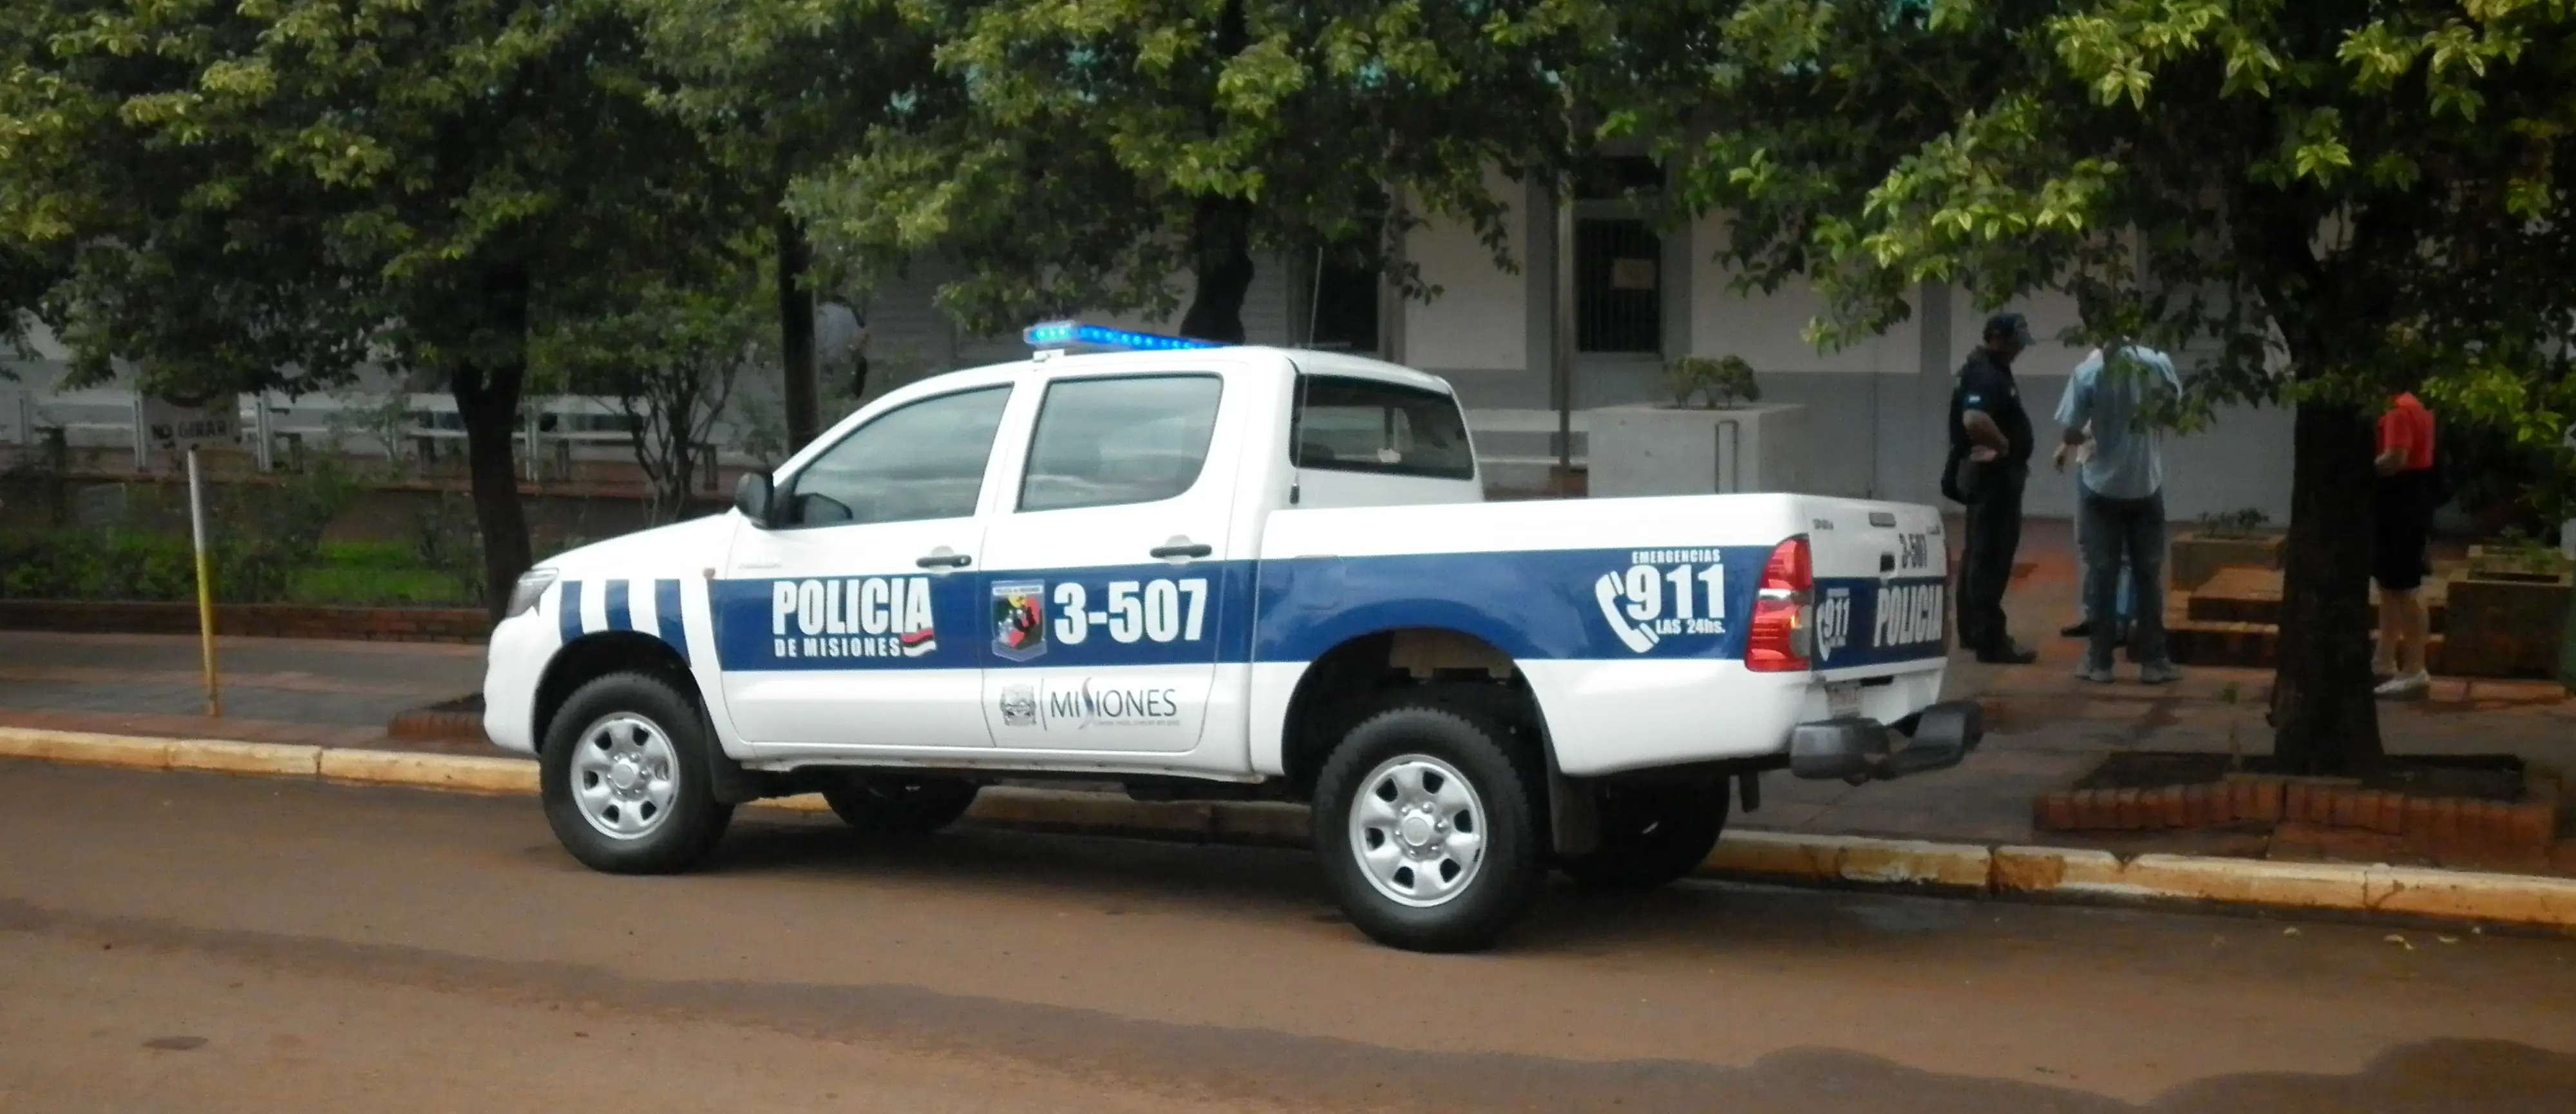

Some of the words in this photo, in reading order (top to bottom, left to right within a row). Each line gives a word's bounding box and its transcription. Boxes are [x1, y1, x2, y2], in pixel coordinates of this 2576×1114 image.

[1632, 549, 1721, 564] EMERGENCIAS
[773, 577, 934, 636] POLICIA
[1054, 578, 1208, 645] 3-507
[1625, 563, 1725, 621] 911
[1824, 598, 1850, 638] 911
[1873, 584, 1944, 647] POLICIA
[774, 637, 797, 657] DE
[804, 637, 901, 657] MISIONES
[1655, 618, 1681, 635] LAS
[1050, 677, 1178, 730] MISIONES
